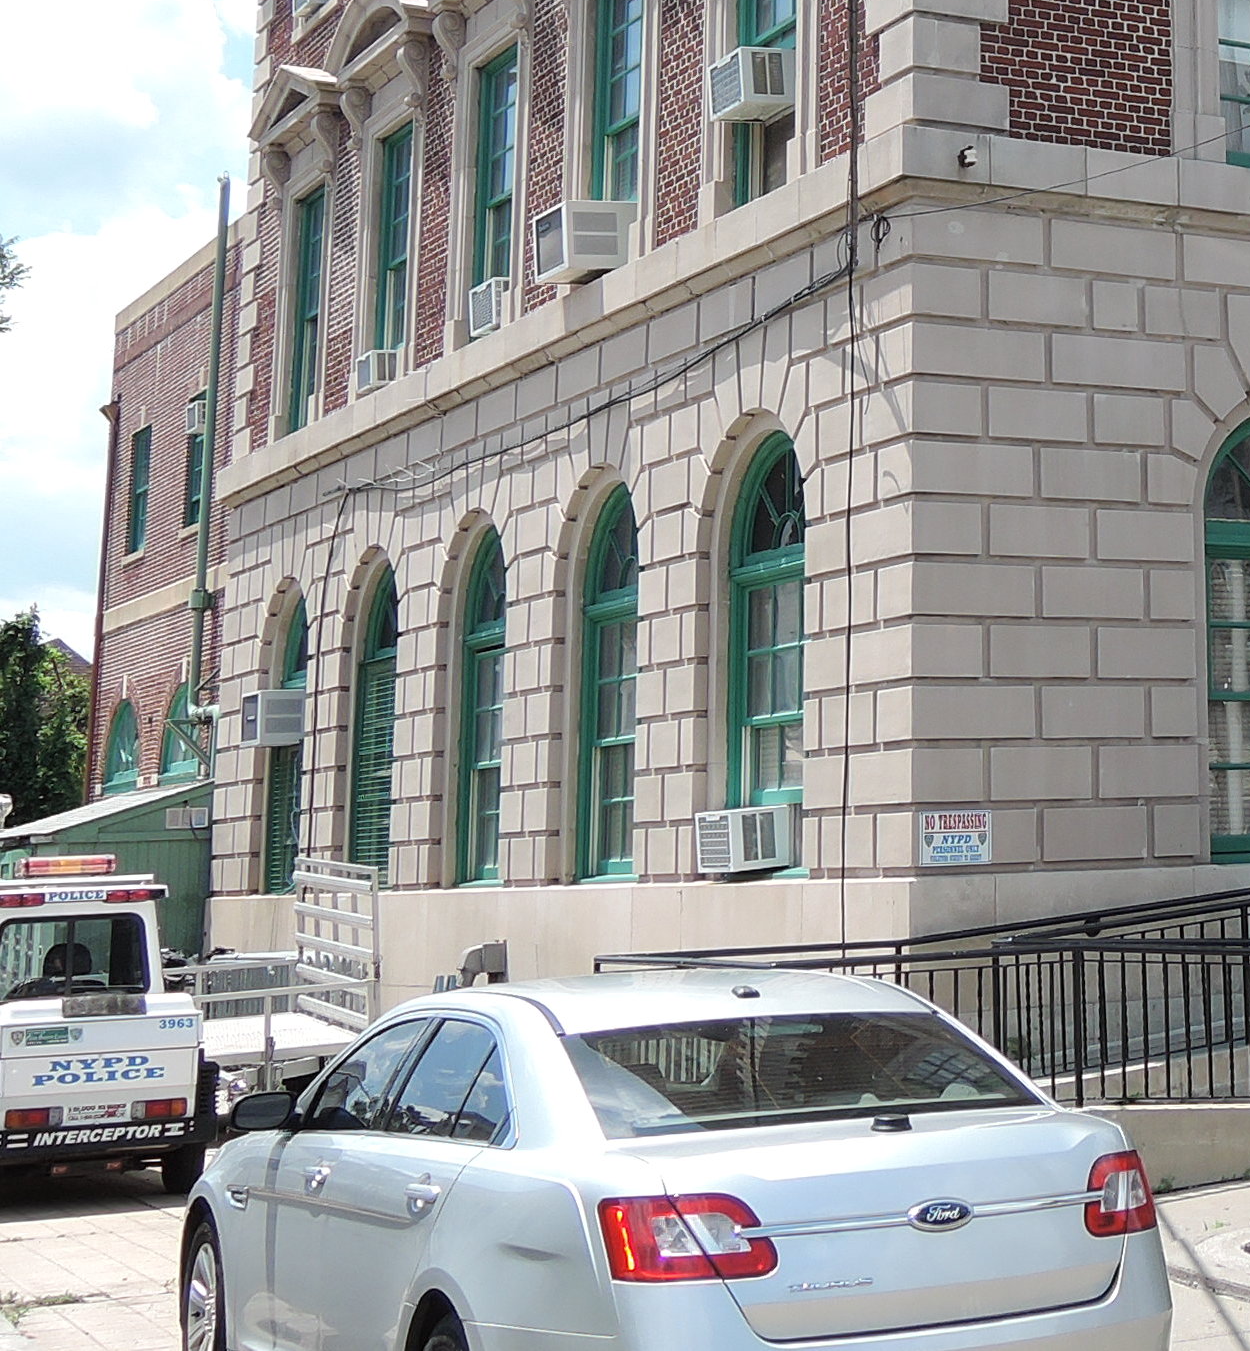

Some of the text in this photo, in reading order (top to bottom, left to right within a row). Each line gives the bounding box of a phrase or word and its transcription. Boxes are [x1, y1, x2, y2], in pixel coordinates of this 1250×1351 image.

[924, 813, 987, 830] NO TRESPASSING
[941, 835, 972, 844] NYPD
[48, 890, 104, 901] POLICE
[159, 1018, 194, 1029] 3963
[49, 1055, 149, 1072] NYPD
[32, 1066, 165, 1087] POLICE
[33, 1124, 161, 1147] INTERCEPTOR
[926, 1204, 961, 1223] Ford
